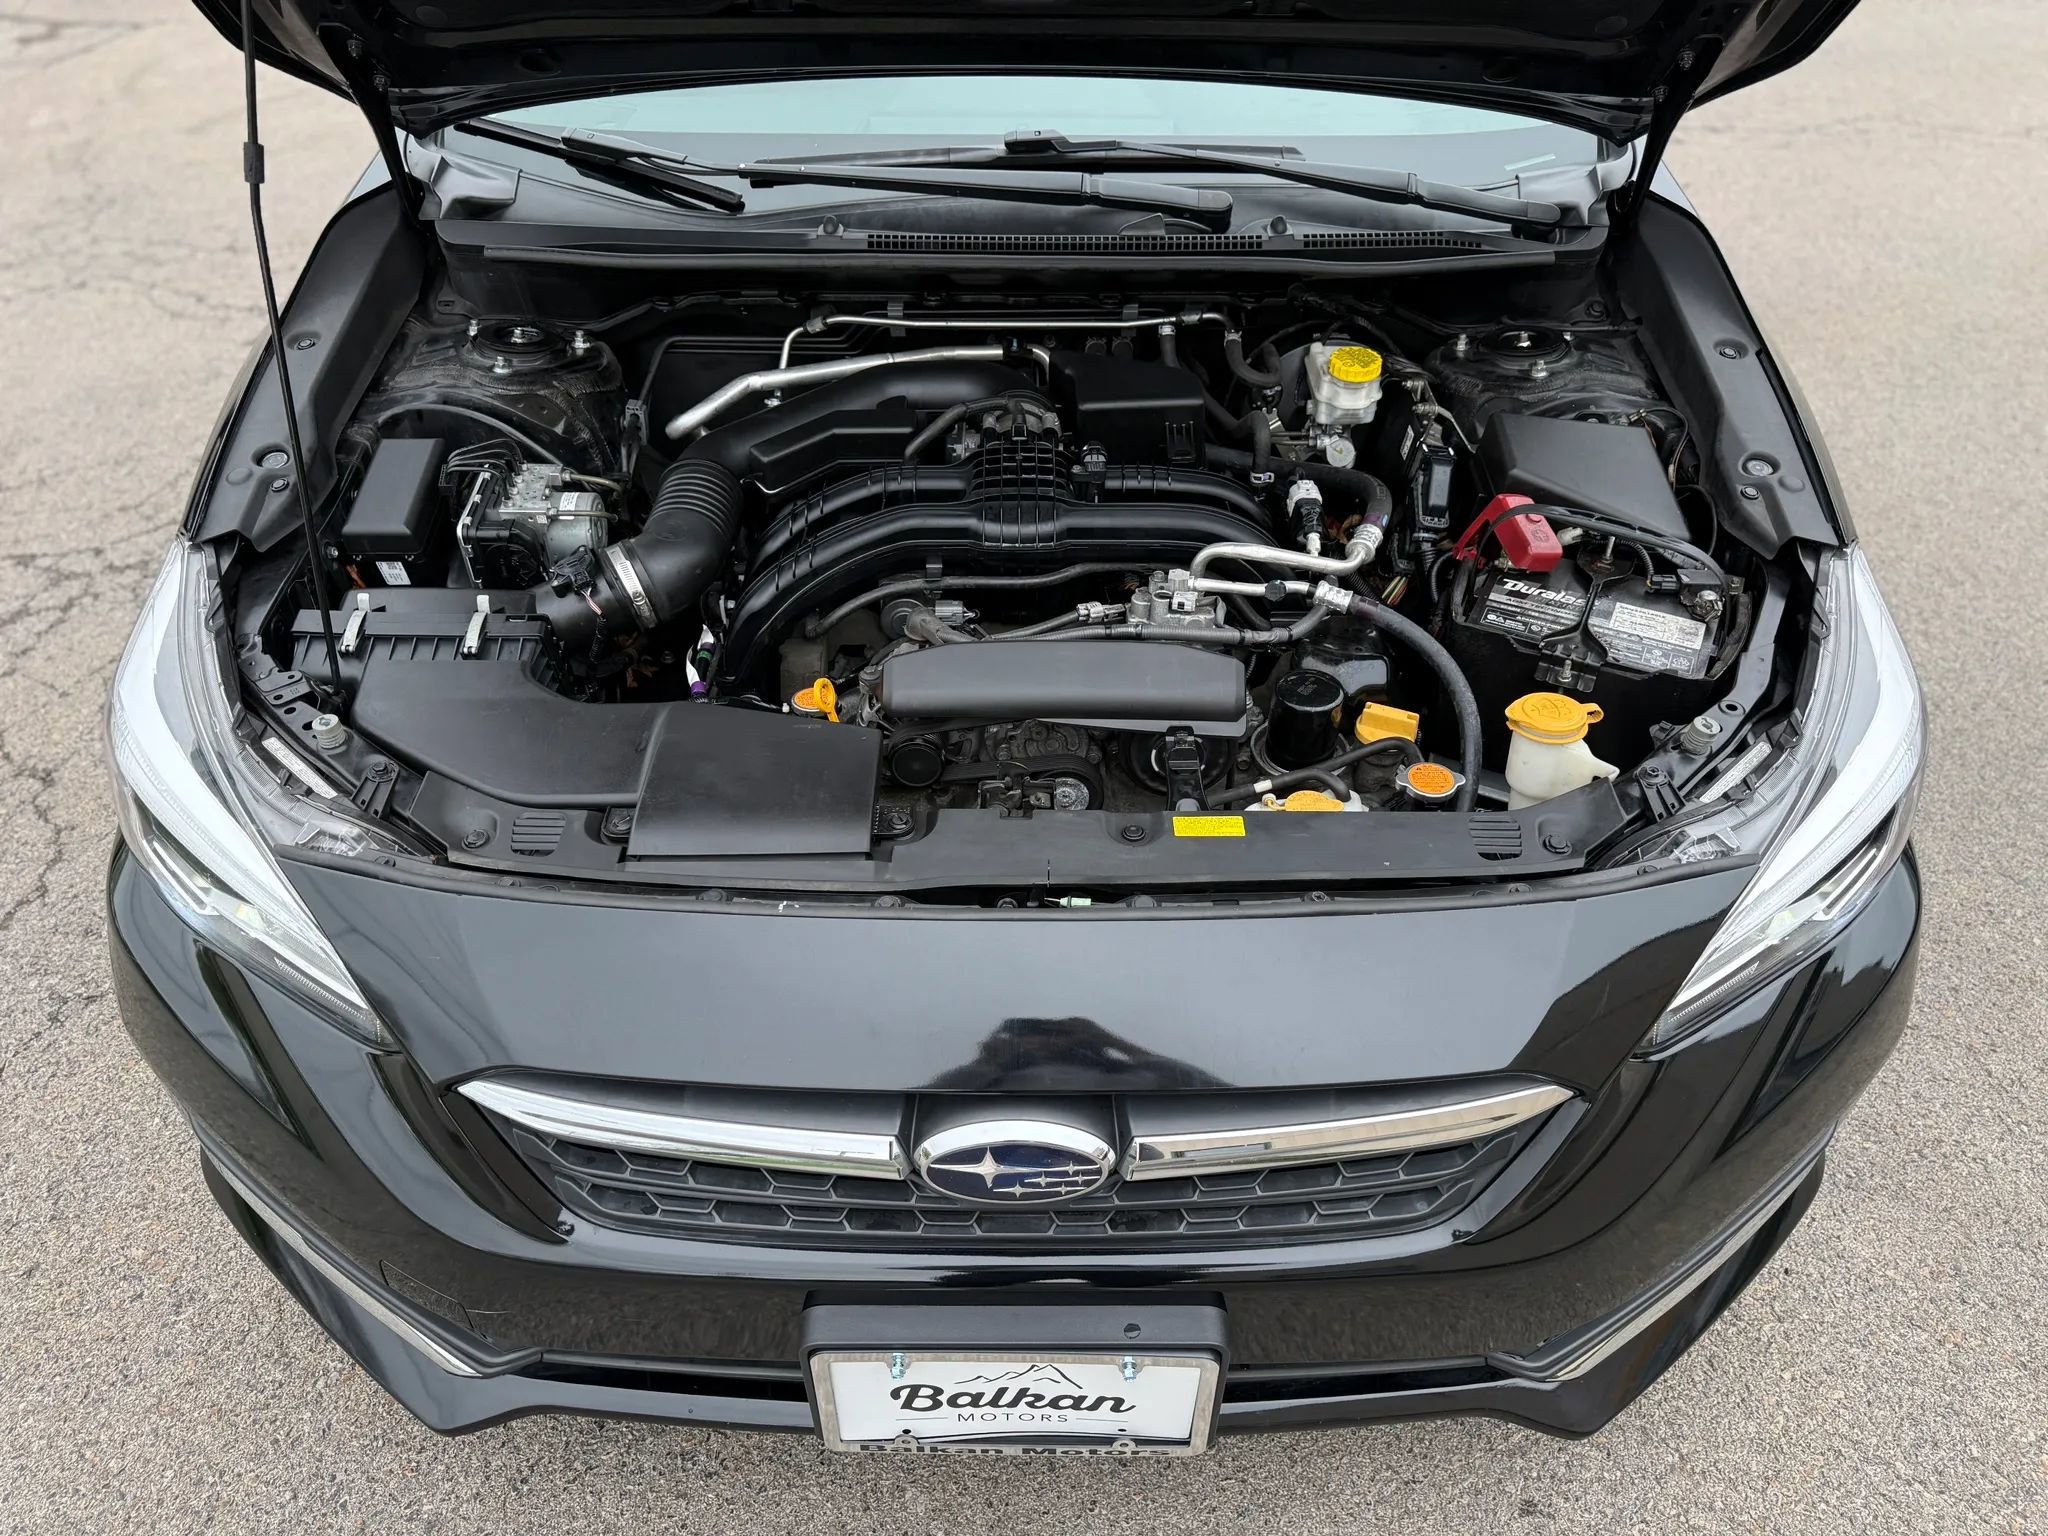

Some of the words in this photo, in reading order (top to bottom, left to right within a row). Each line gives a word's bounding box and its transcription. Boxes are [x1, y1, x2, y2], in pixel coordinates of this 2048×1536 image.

[1503, 578, 1600, 609] Duralas
[890, 1383, 1136, 1413] Balkan
[957, 1412, 1068, 1423] MOTORS
[859, 1444, 1003, 1454] Balkan
[1021, 1447, 1170, 1456] Motors
